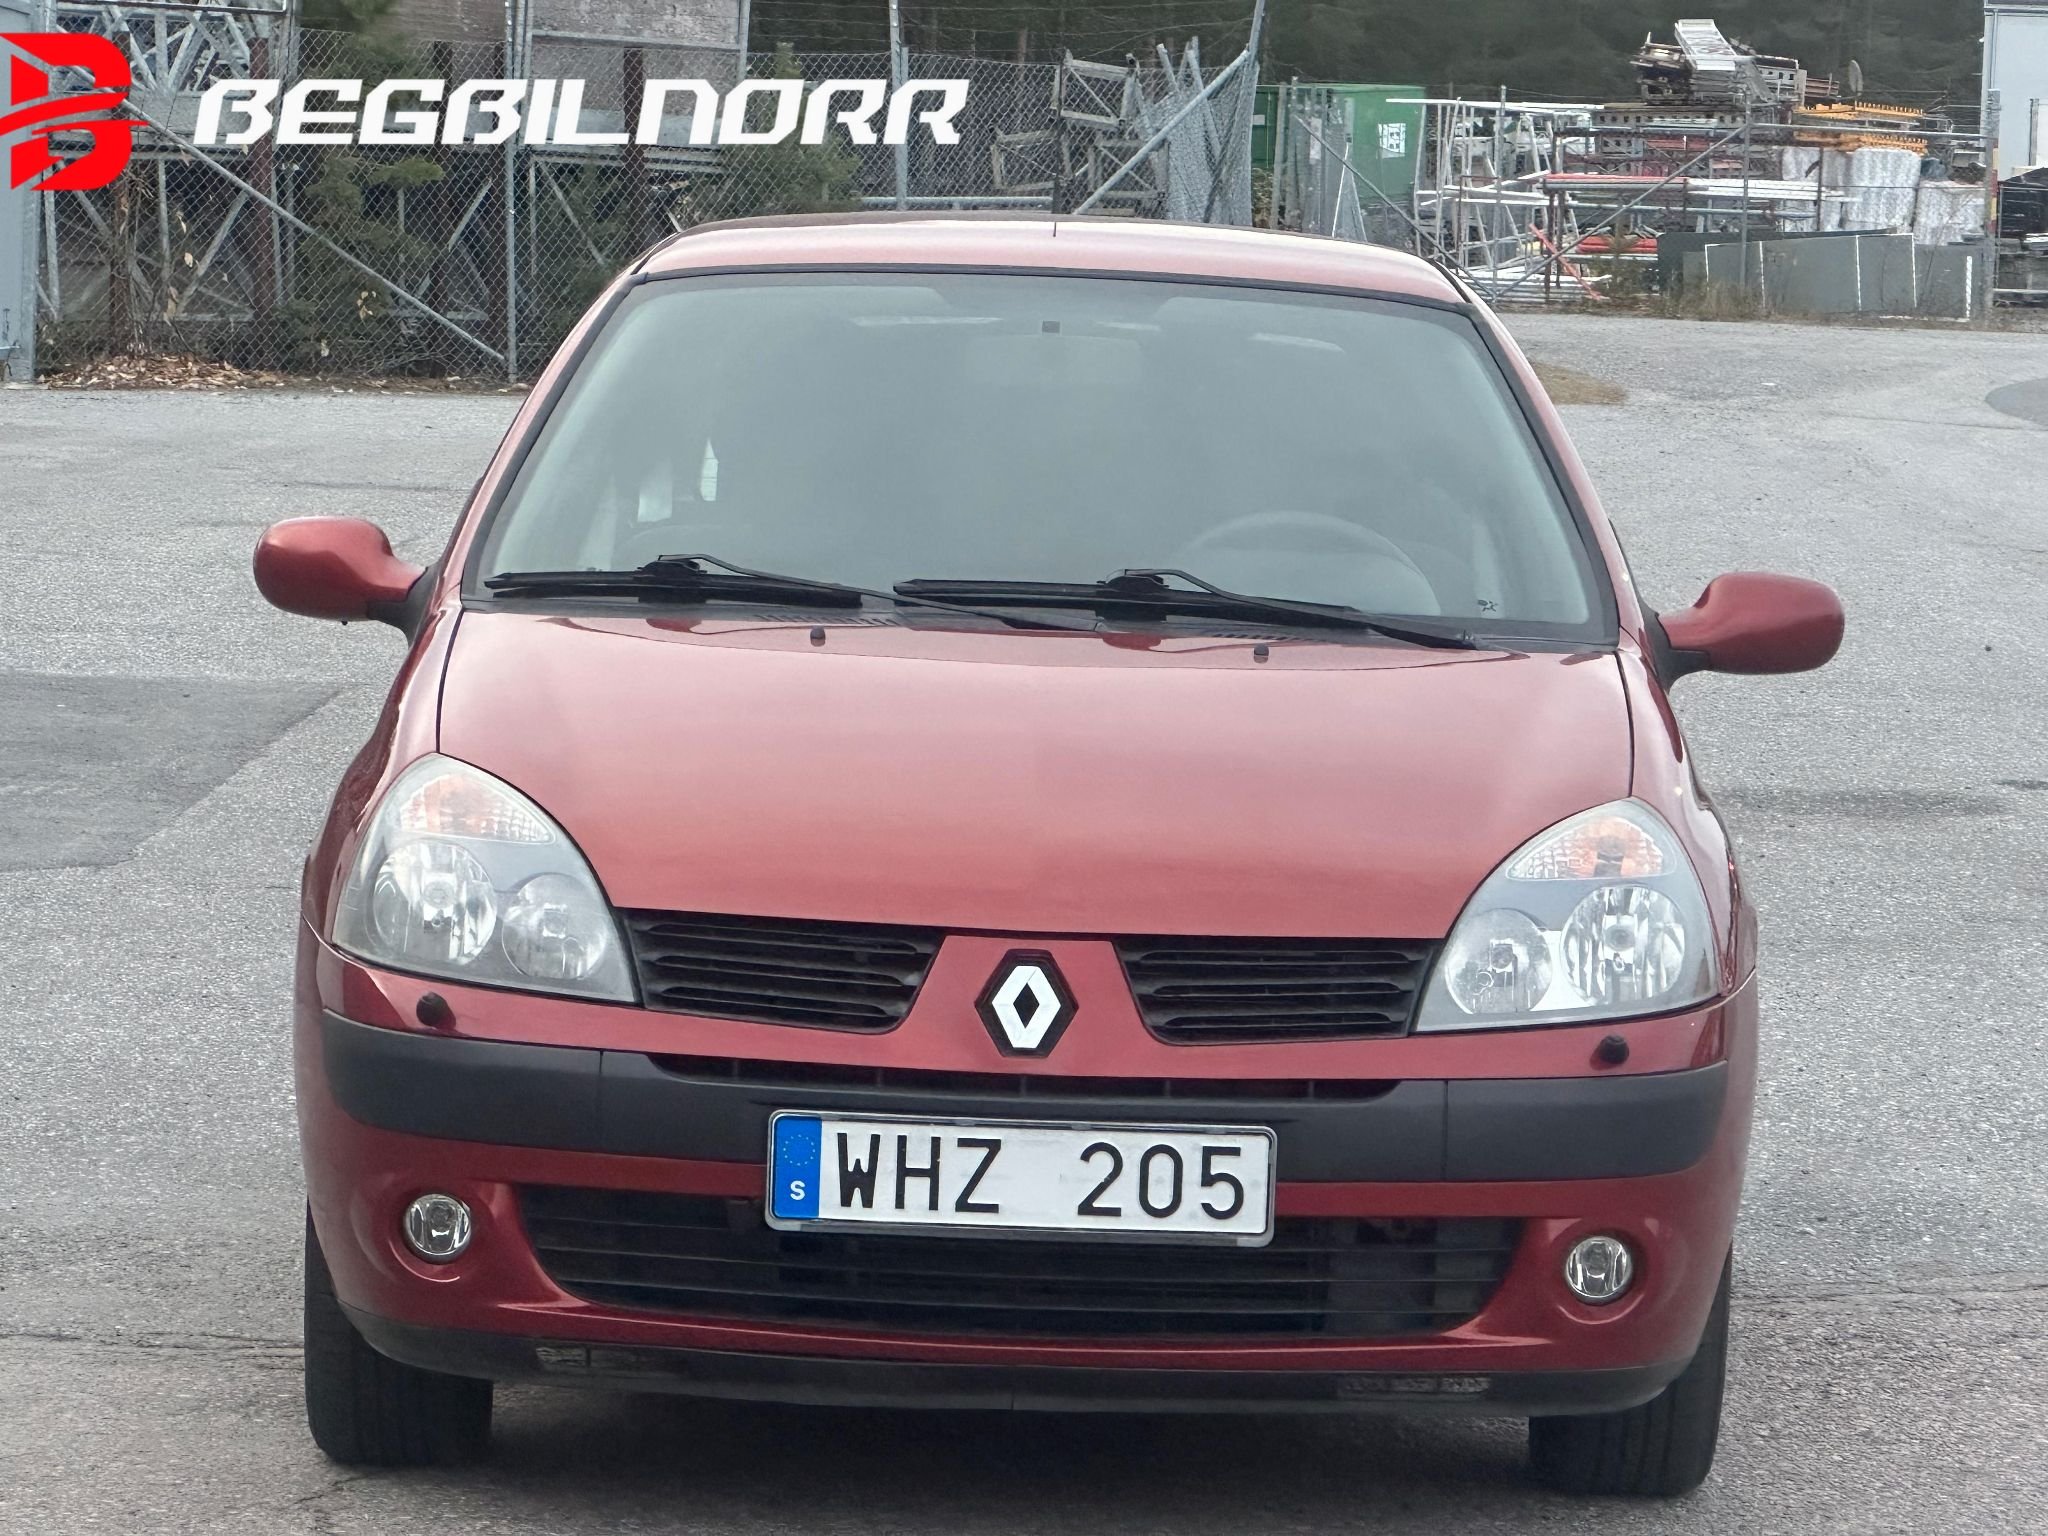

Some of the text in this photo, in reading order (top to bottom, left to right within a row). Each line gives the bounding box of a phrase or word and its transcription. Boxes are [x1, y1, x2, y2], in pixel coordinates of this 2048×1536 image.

[789, 1180, 806, 1201] S
[836, 1132, 1244, 1220] WHZ 205
